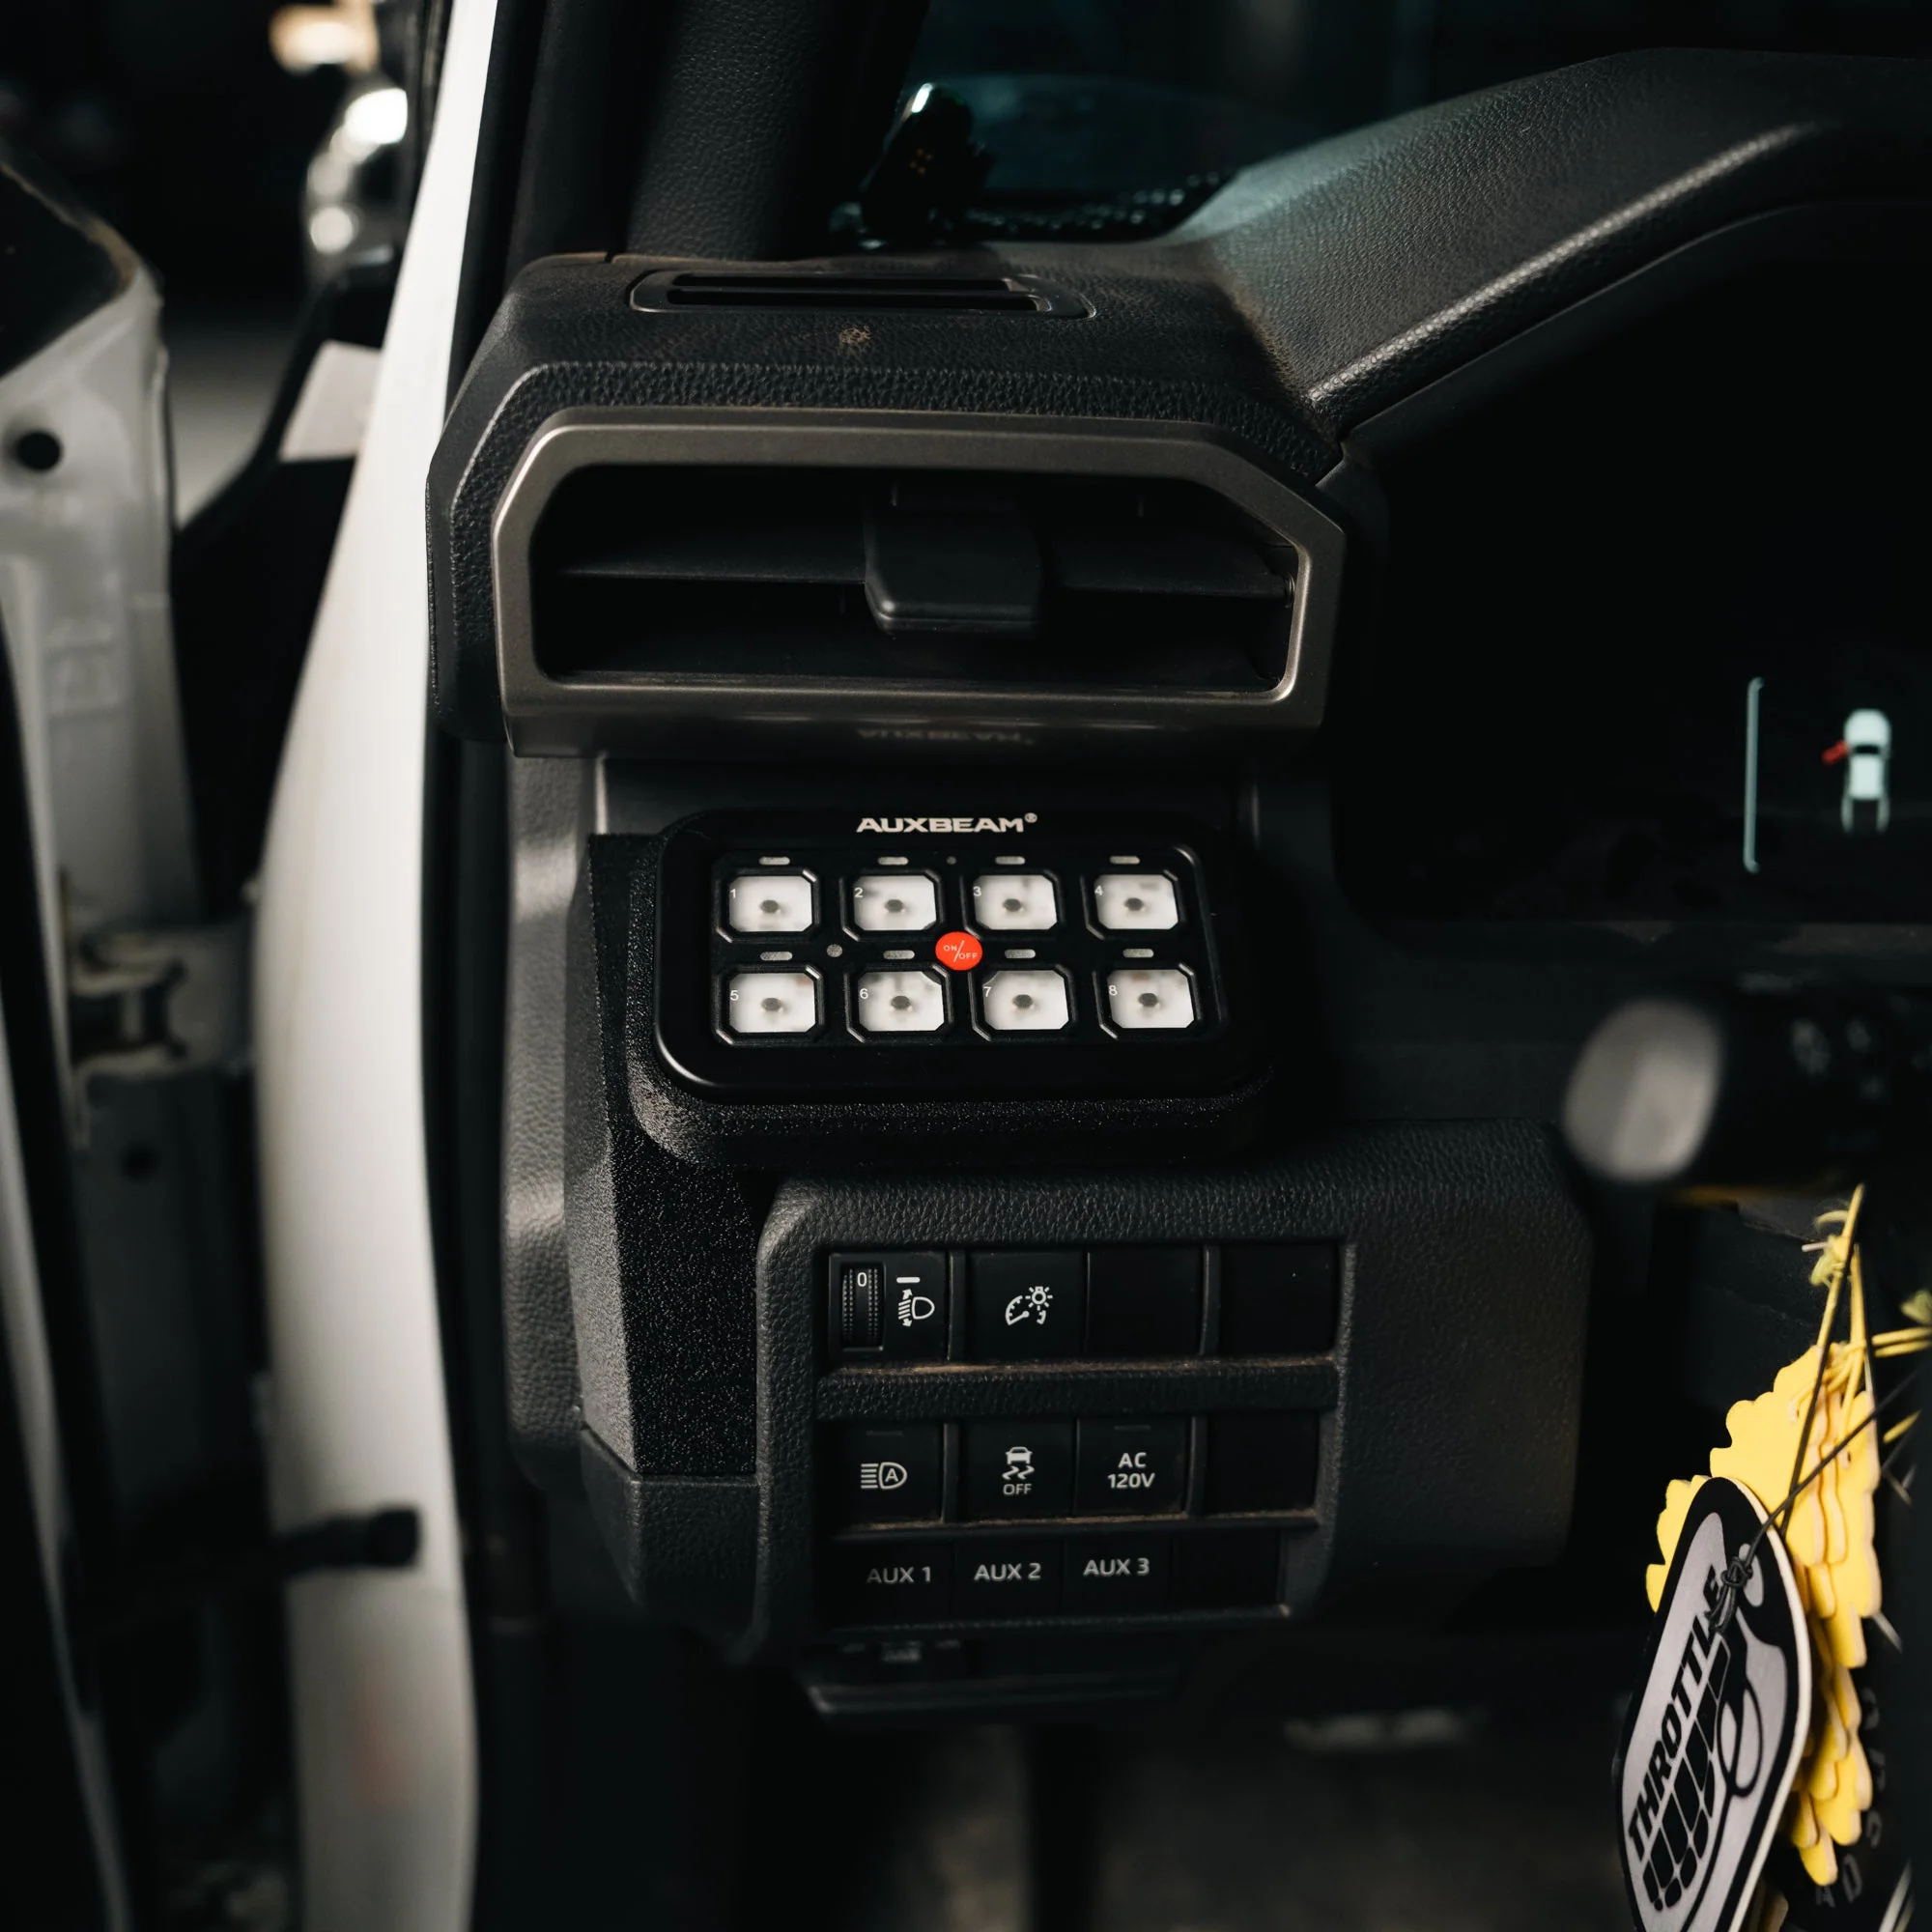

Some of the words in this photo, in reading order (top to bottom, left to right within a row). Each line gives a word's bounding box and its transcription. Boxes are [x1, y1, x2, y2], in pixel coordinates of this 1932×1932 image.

[729, 888, 737, 899] 1
[854, 887, 864, 898] 2
[973, 886, 982, 896] 3
[1094, 885, 1104, 896] 4
[729, 989, 739, 1001] 5
[859, 988, 869, 999] 6
[982, 986, 992, 997] 7
[1108, 984, 1118, 996] 8
[857, 1272, 867, 1288] 0
[1118, 1452, 1148, 1469] AC
[1107, 1473, 1156, 1490] 120V
[1003, 1483, 1033, 1496] OFF
[974, 1563, 1022, 1581] AUX
[1027, 1562, 1041, 1580] 2
[1083, 1558, 1131, 1577] AUX
[1136, 1557, 1150, 1576] 3
[867, 1567, 915, 1584] AUX
[921, 1566, 932, 1583] 1
